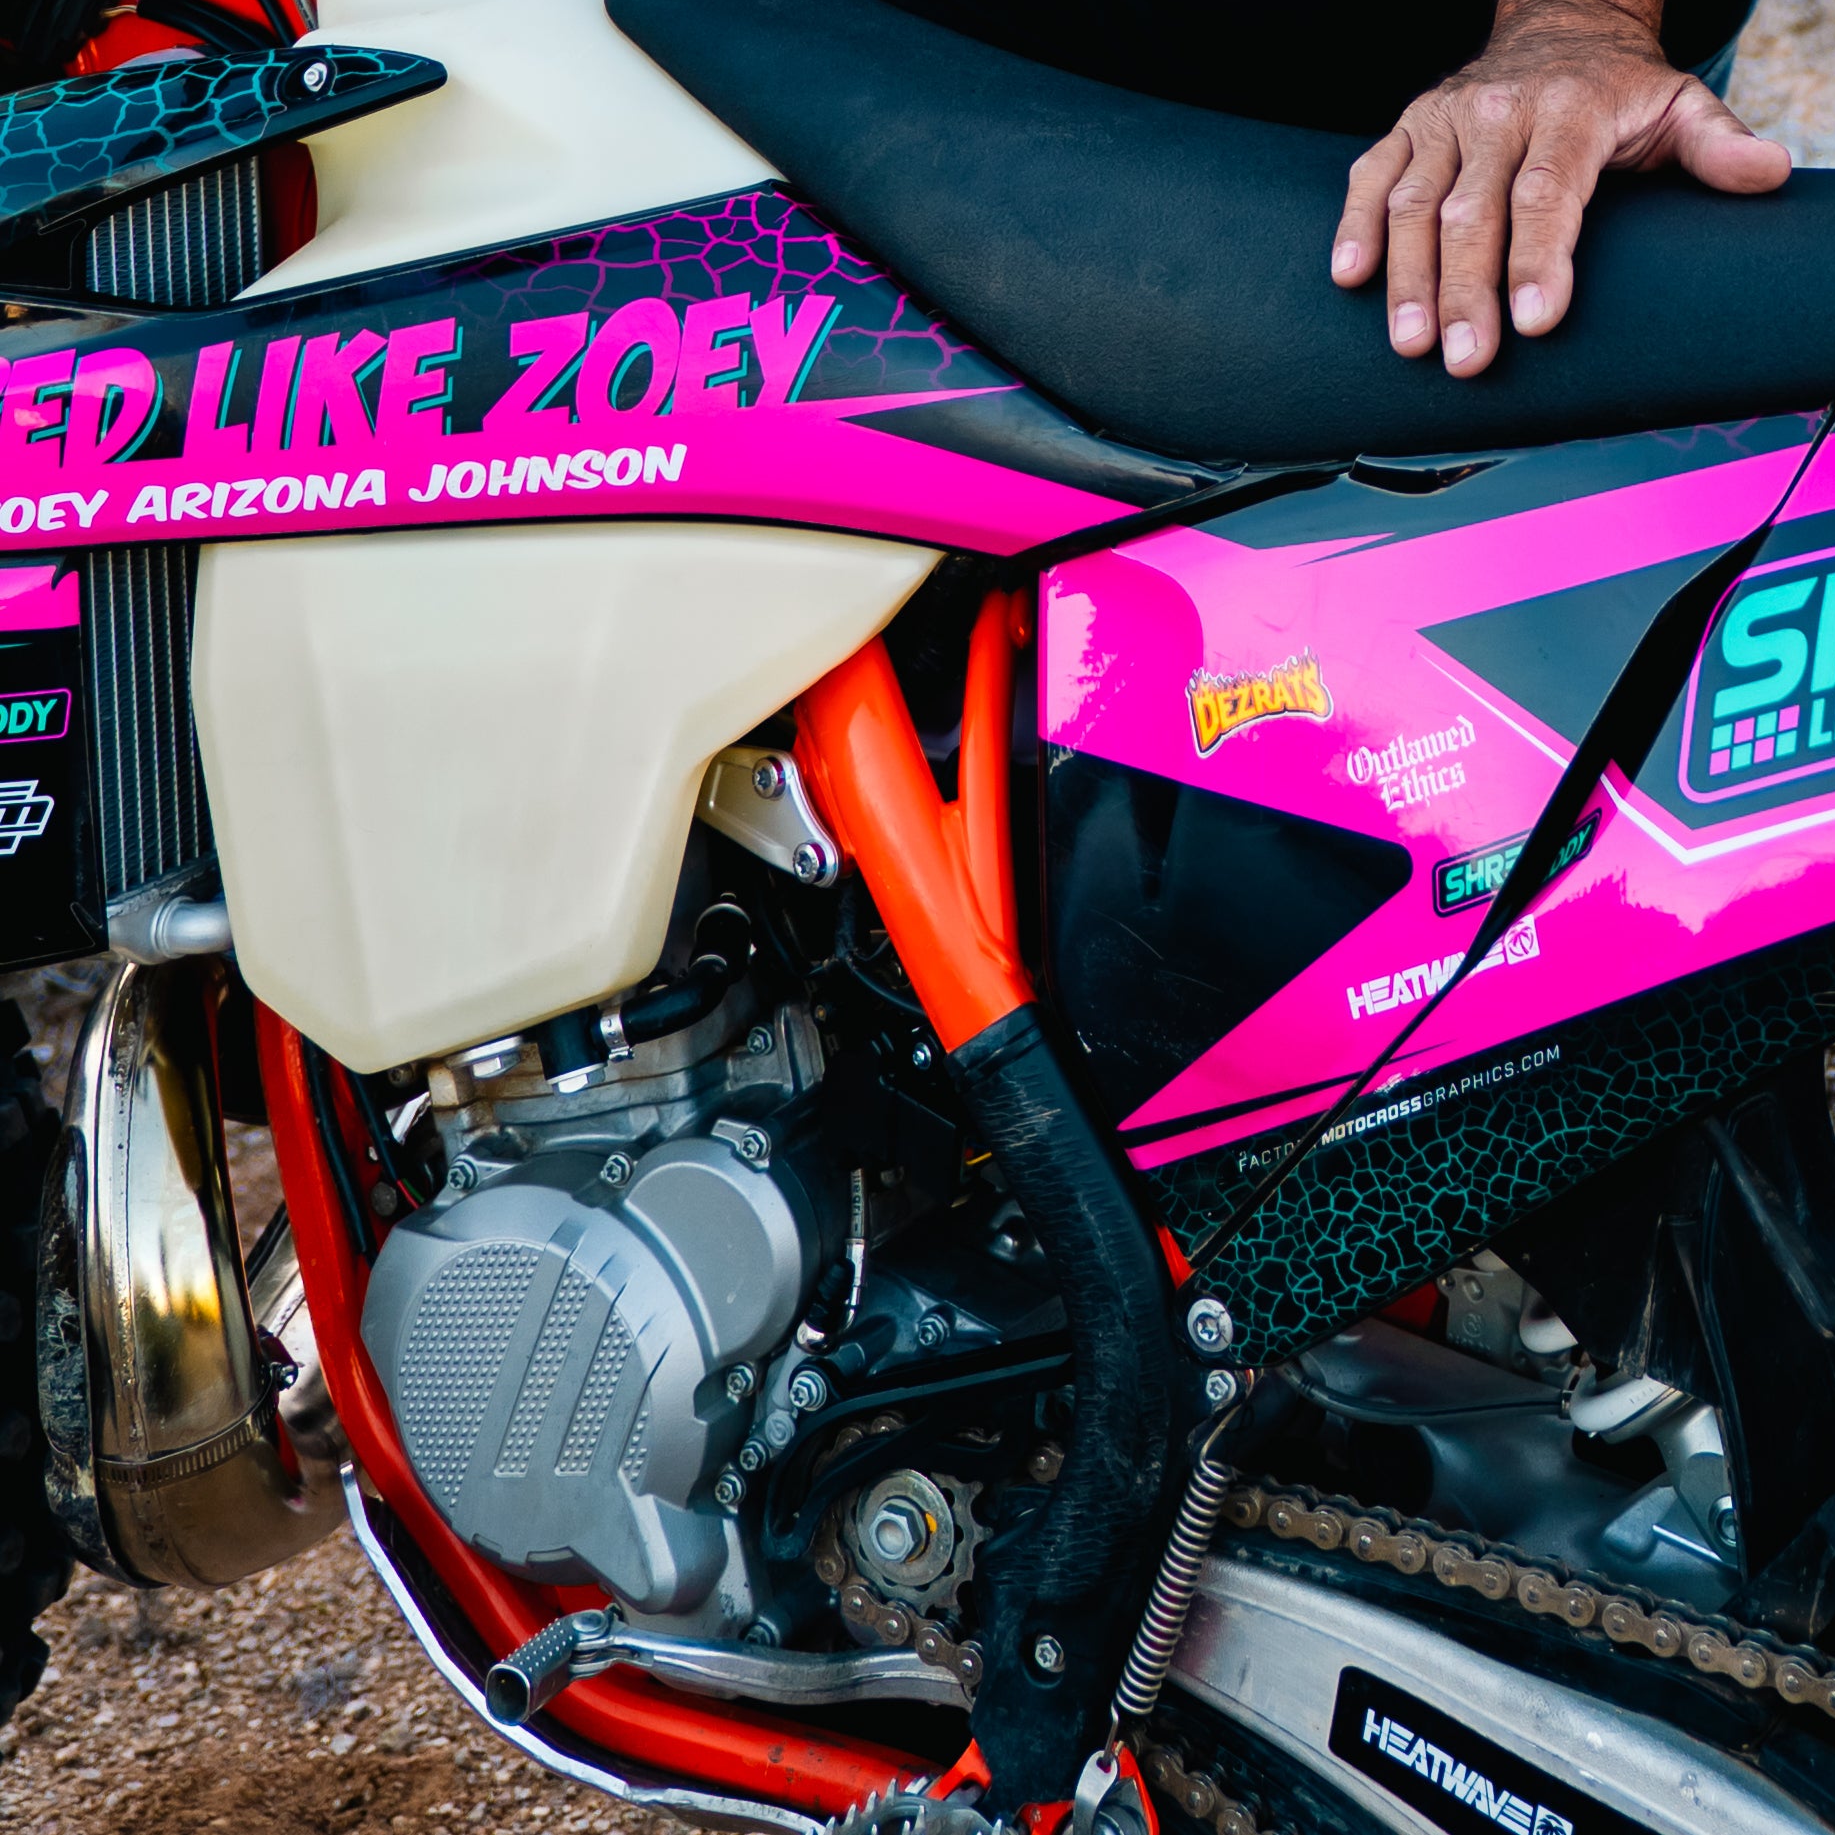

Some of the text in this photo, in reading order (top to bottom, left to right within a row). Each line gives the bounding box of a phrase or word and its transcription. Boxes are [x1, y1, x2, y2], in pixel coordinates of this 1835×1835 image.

[0, 291, 843, 468] ED LIKE ZOEY
[0, 443, 688, 534] OEY ARIZONA JOHNSON
[1191, 662, 1330, 752] DEZRATS
[1346, 714, 1477, 785] Outlawed
[1377, 761, 1467, 813] Ethics
[1346, 940, 1506, 1020] HEATWAE
[1362, 1706, 1535, 1835] HEATWAVE
